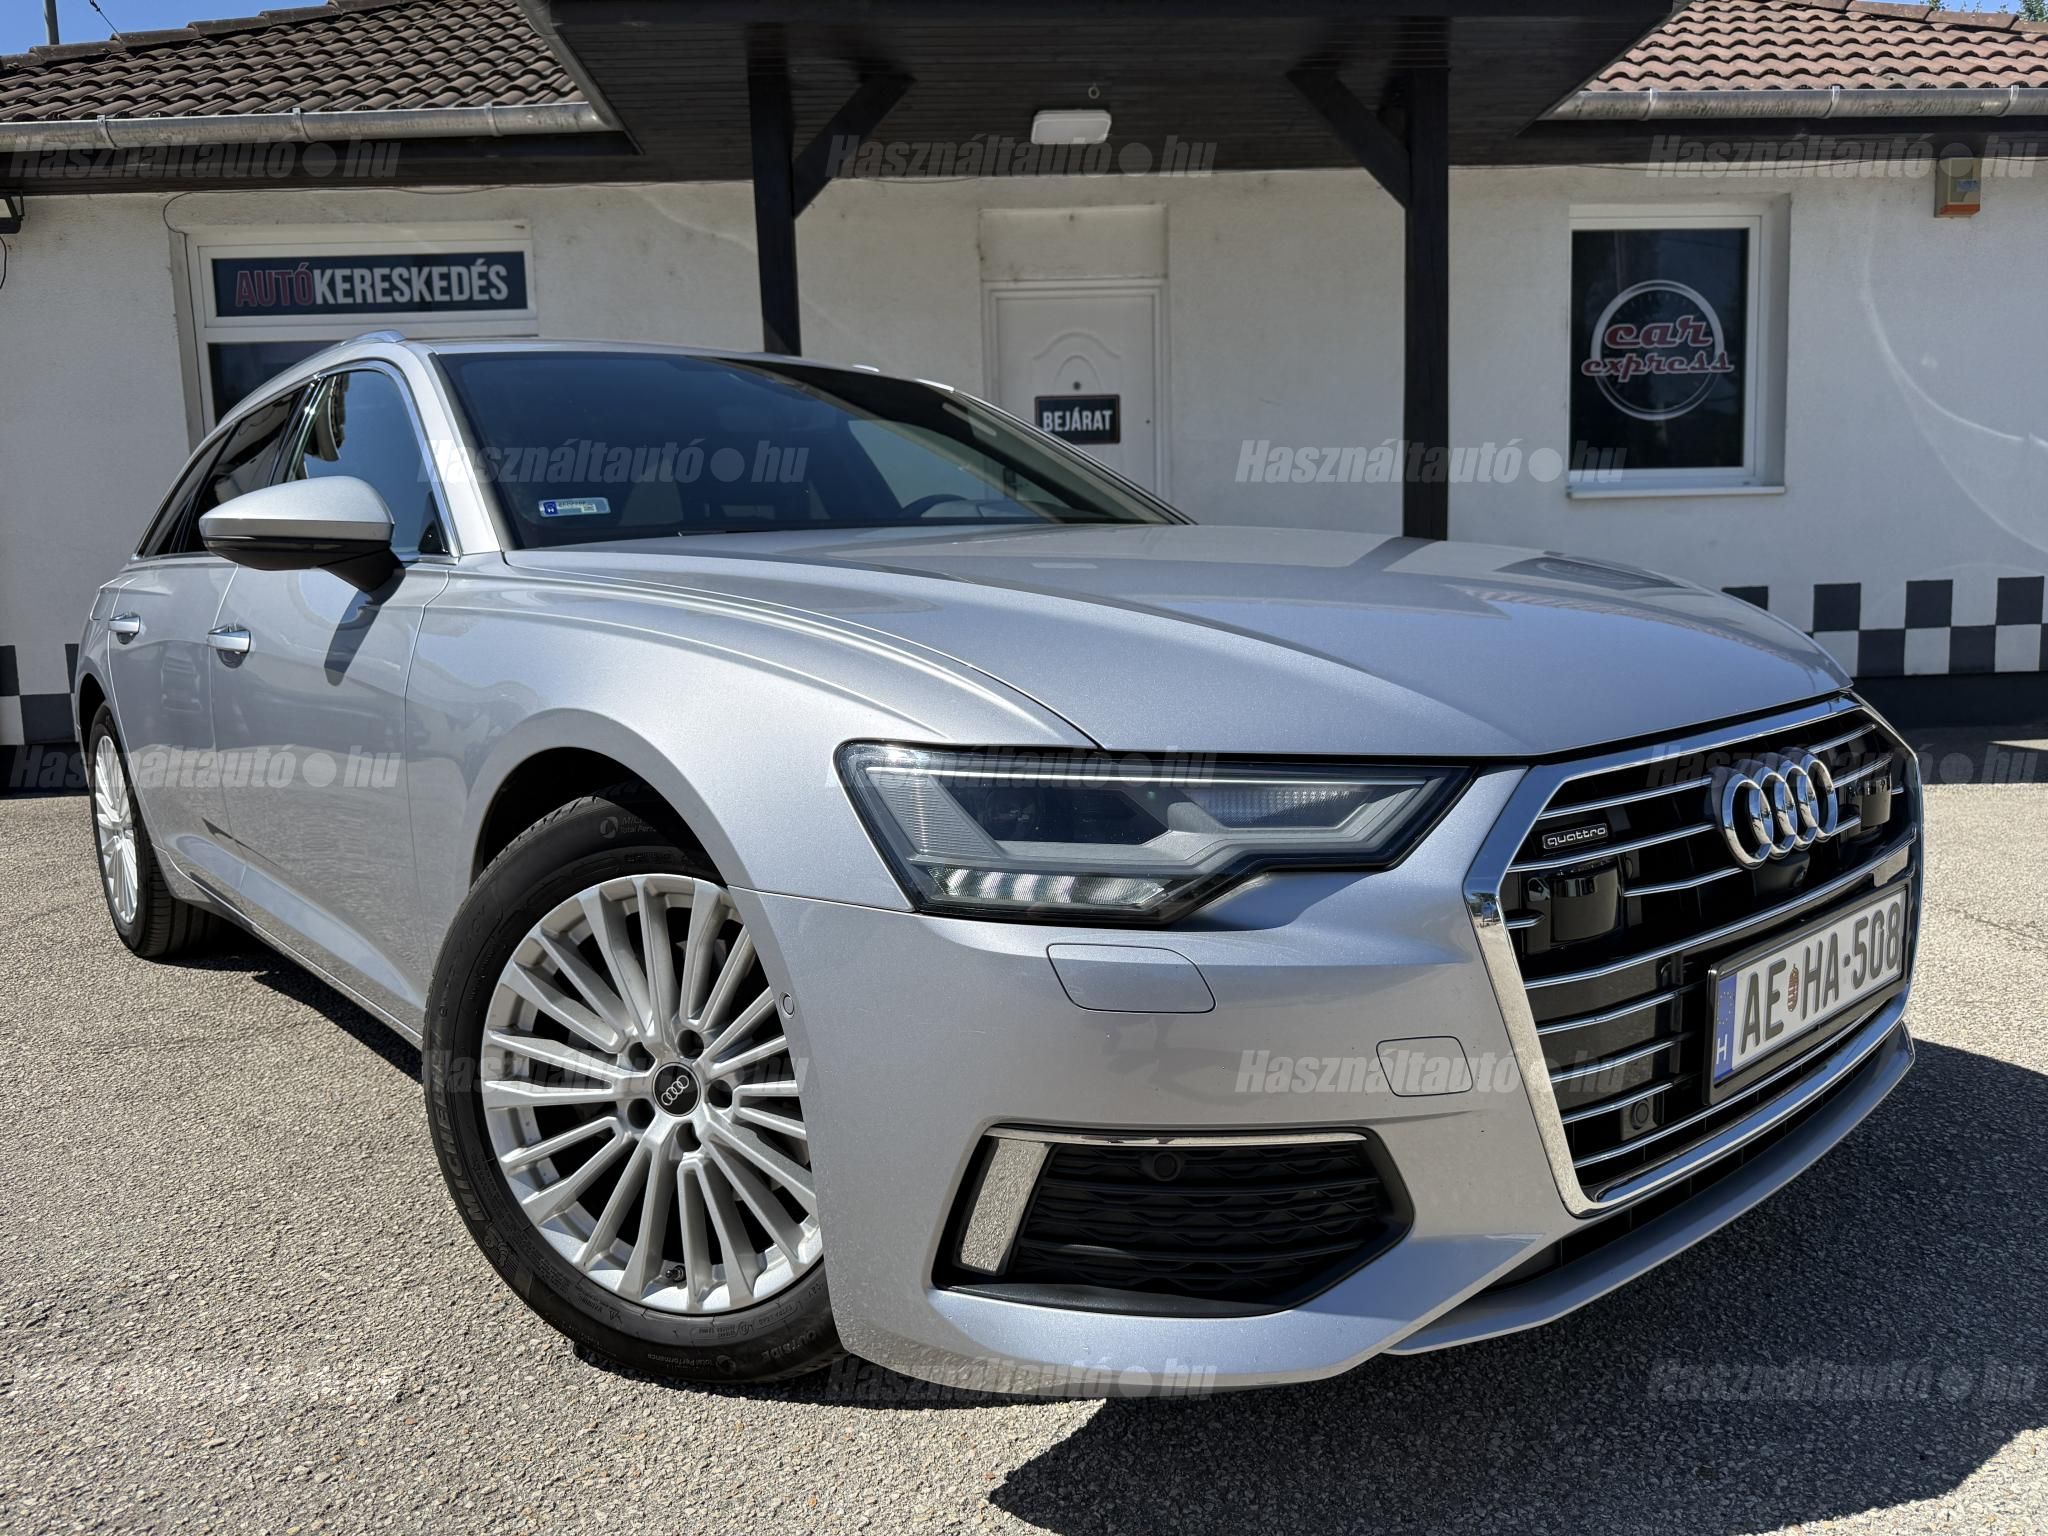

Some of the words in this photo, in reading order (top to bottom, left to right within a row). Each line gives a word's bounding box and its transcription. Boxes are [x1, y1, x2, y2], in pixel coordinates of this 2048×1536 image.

[235, 258, 509, 307] AUTÓKERESKEDÉS
[1604, 315, 1713, 348] car
[1581, 351, 1735, 383] express
[1043, 406, 1113, 432] BEJÁRAT
[1547, 827, 1606, 846] quattro
[1739, 957, 1787, 1055] AE
